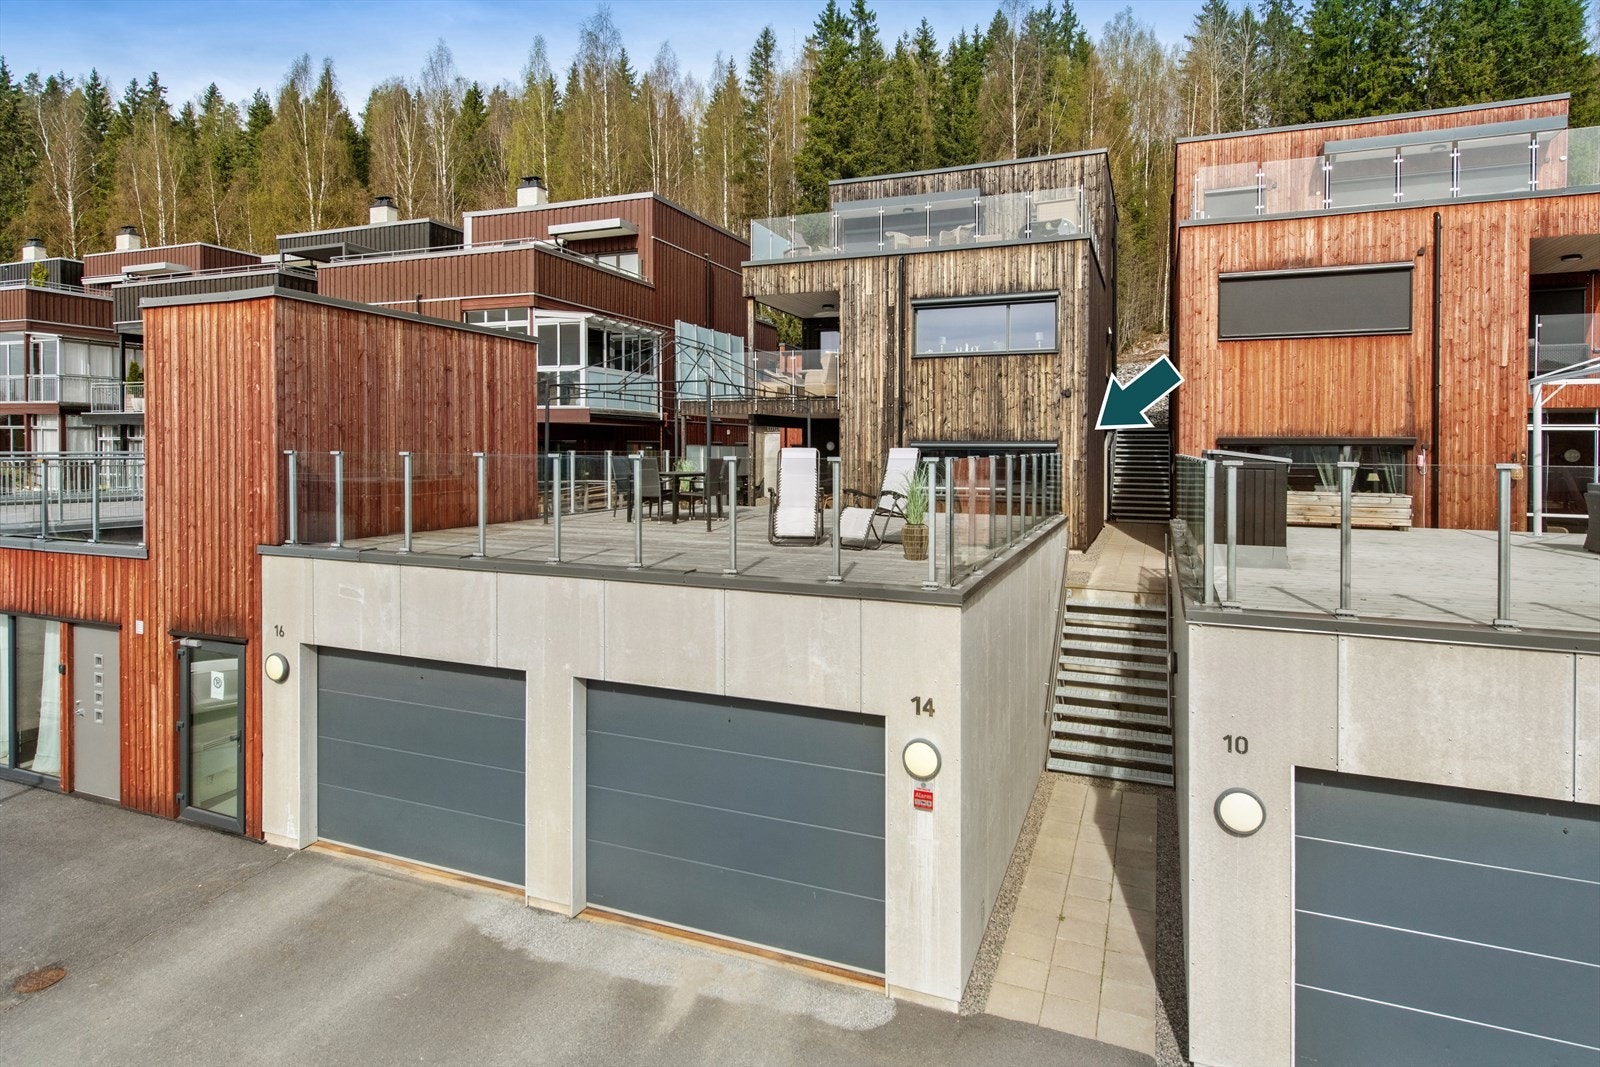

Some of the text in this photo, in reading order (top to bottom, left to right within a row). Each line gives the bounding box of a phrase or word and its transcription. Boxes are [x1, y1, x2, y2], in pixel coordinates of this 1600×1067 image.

[274, 624, 285, 638] 16
[910, 696, 935, 717] 14
[1222, 734, 1249, 754] 10
